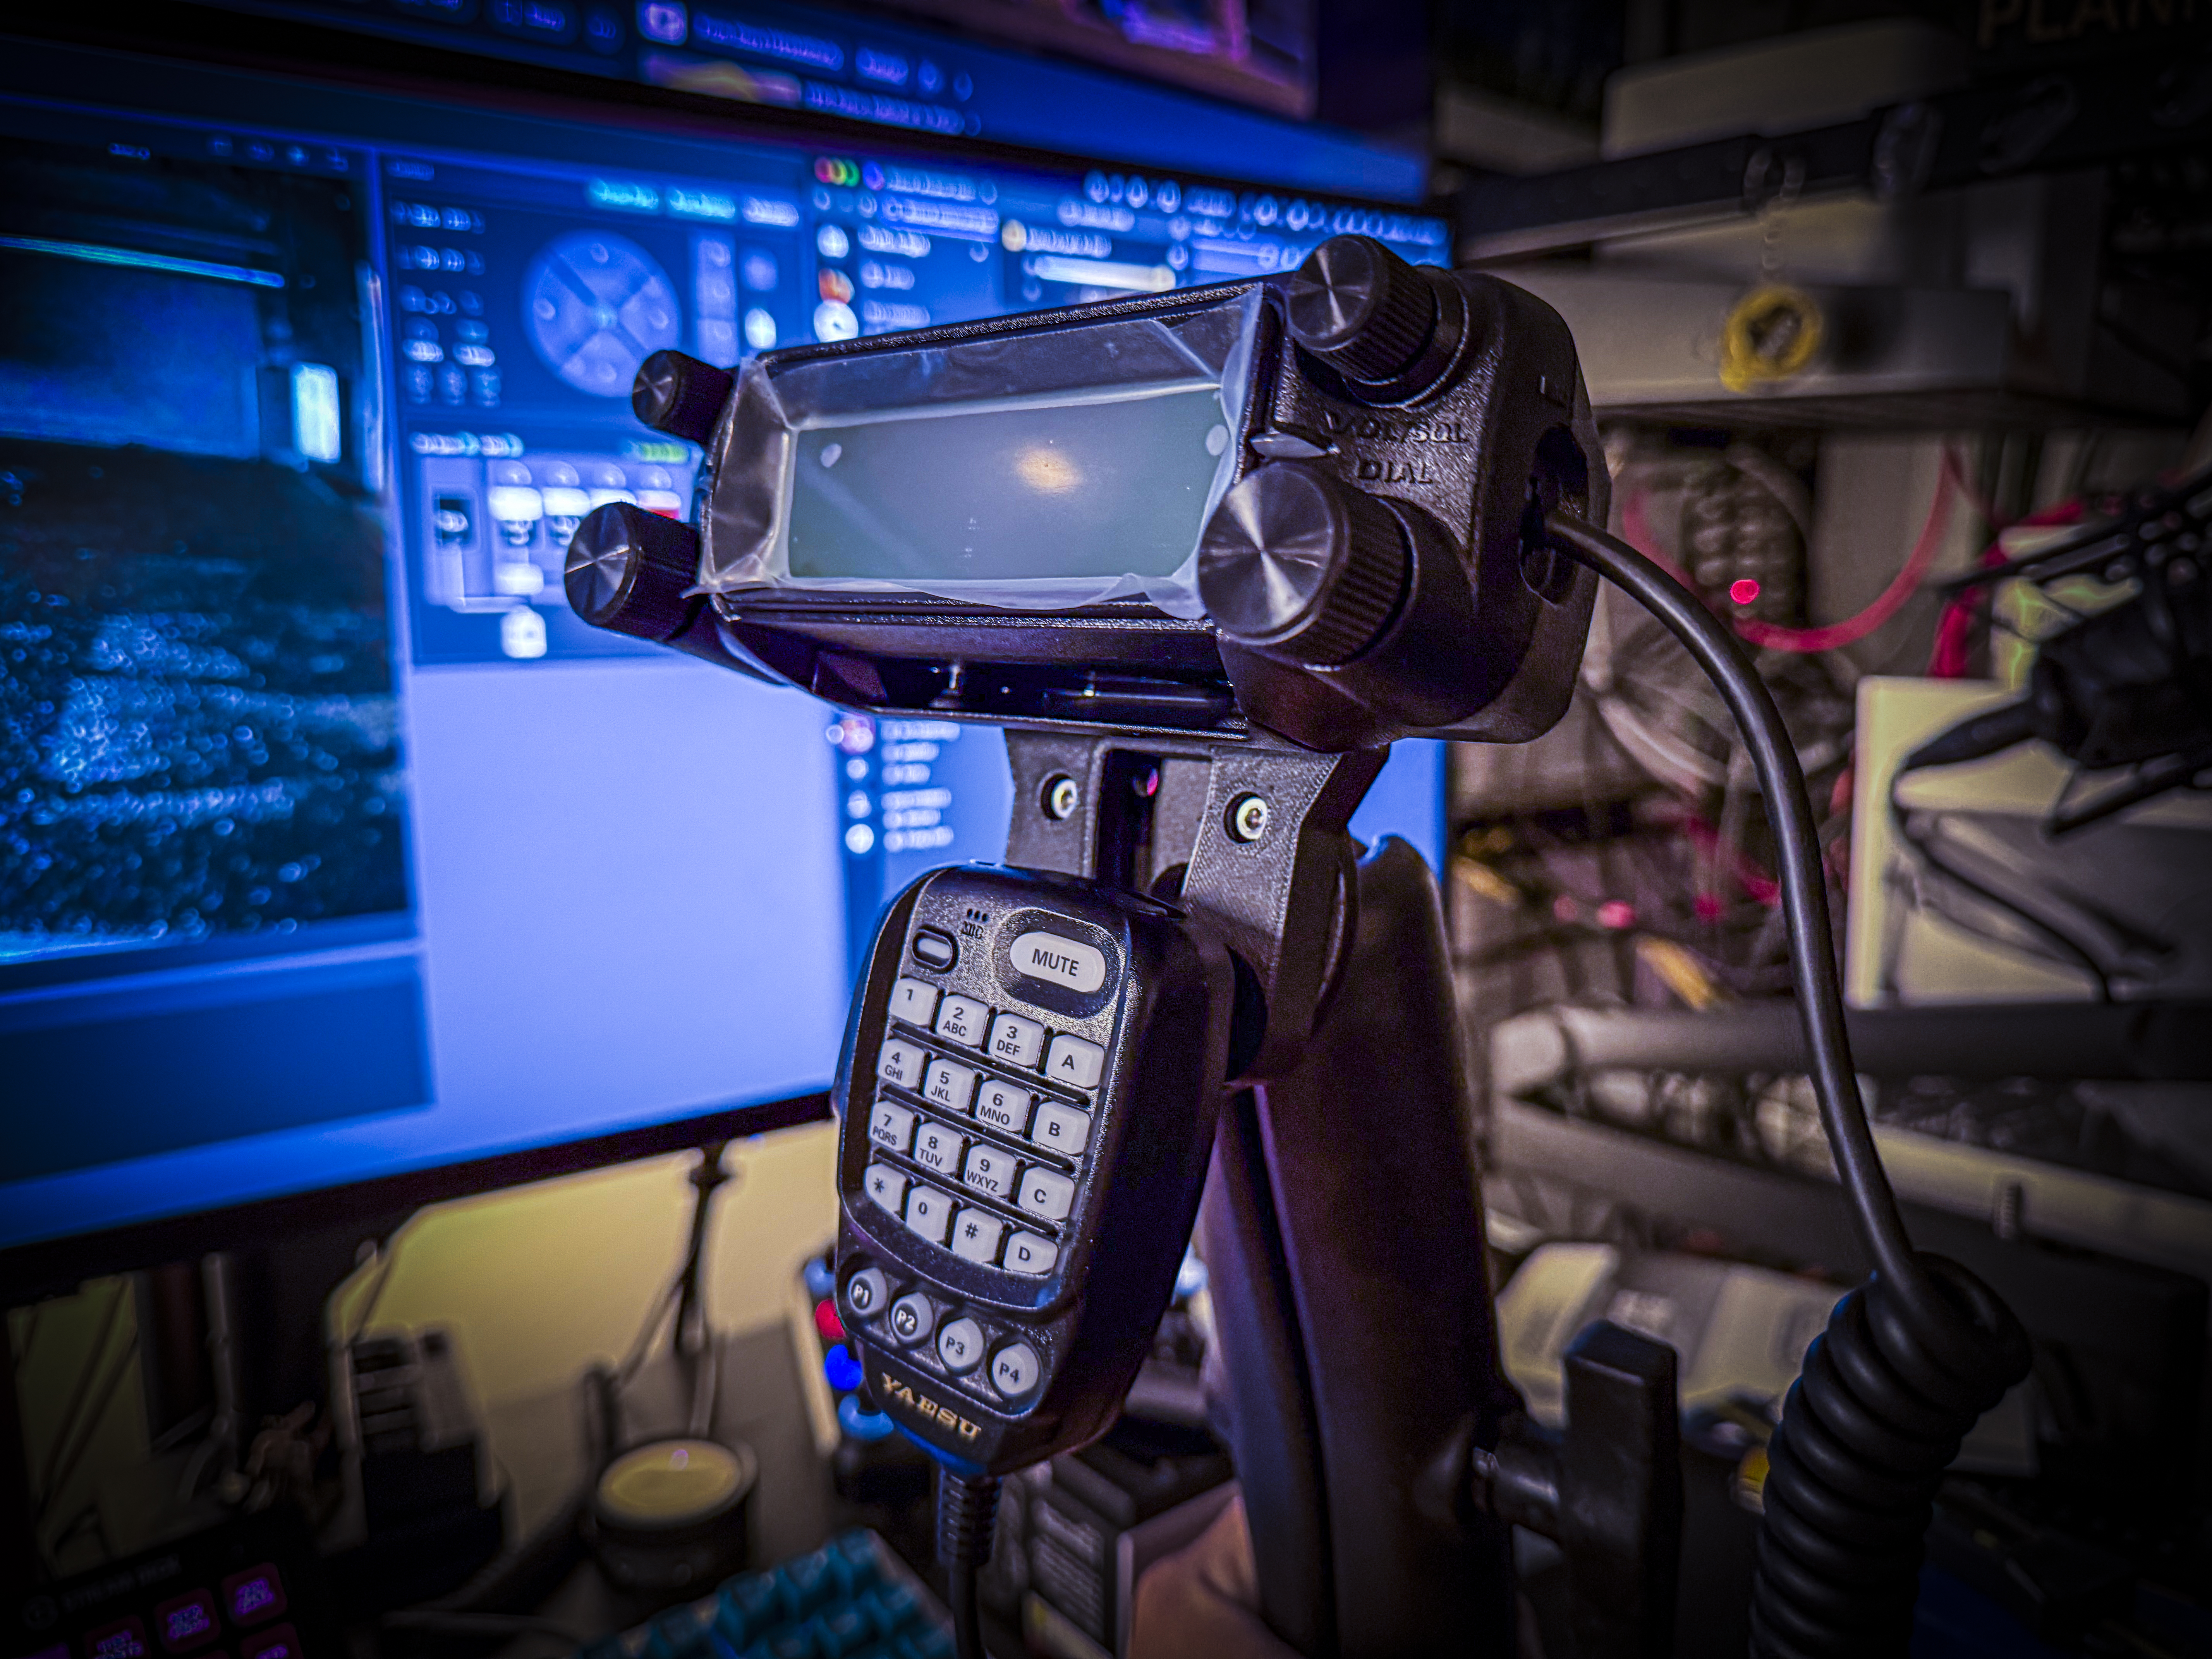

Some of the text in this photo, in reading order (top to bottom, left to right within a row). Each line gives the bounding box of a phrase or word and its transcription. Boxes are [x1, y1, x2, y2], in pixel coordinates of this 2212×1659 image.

[1355, 459, 1433, 483] DIAL
[961, 921, 984, 939] MIC
[1032, 948, 1079, 977] MUTE
[907, 989, 914, 1001] 1
[953, 1006, 964, 1020] 2
[943, 1020, 967, 1037] ABC
[1006, 1025, 1018, 1039] 3
[996, 1039, 1021, 1056] DEF
[891, 1051, 901, 1064] 4
[1061, 1054, 1075, 1070] A
[884, 1064, 903, 1081] GHI
[940, 1071, 950, 1085] 5
[931, 1087, 950, 1102] JKL
[993, 1093, 1004, 1106] 6
[883, 1114, 893, 1127] 7
[980, 1105, 1010, 1125] MNO
[872, 1125, 897, 1146] PQRS
[1048, 1121, 1061, 1137] B
[928, 1135, 939, 1150] 8
[919, 1147, 943, 1167] TUV
[980, 1158, 991, 1172] 9
[967, 1169, 999, 1192] WXYZ
[1034, 1188, 1047, 1204] C
[918, 1201, 928, 1215] 0
[964, 1222, 979, 1239] #
[1018, 1246, 1031, 1262] D
[853, 1284, 869, 1306] P1
[896, 1309, 916, 1331] P2
[946, 1335, 965, 1356] P3
[999, 1362, 1020, 1384] P4
[882, 1372, 982, 1441] YAESU
